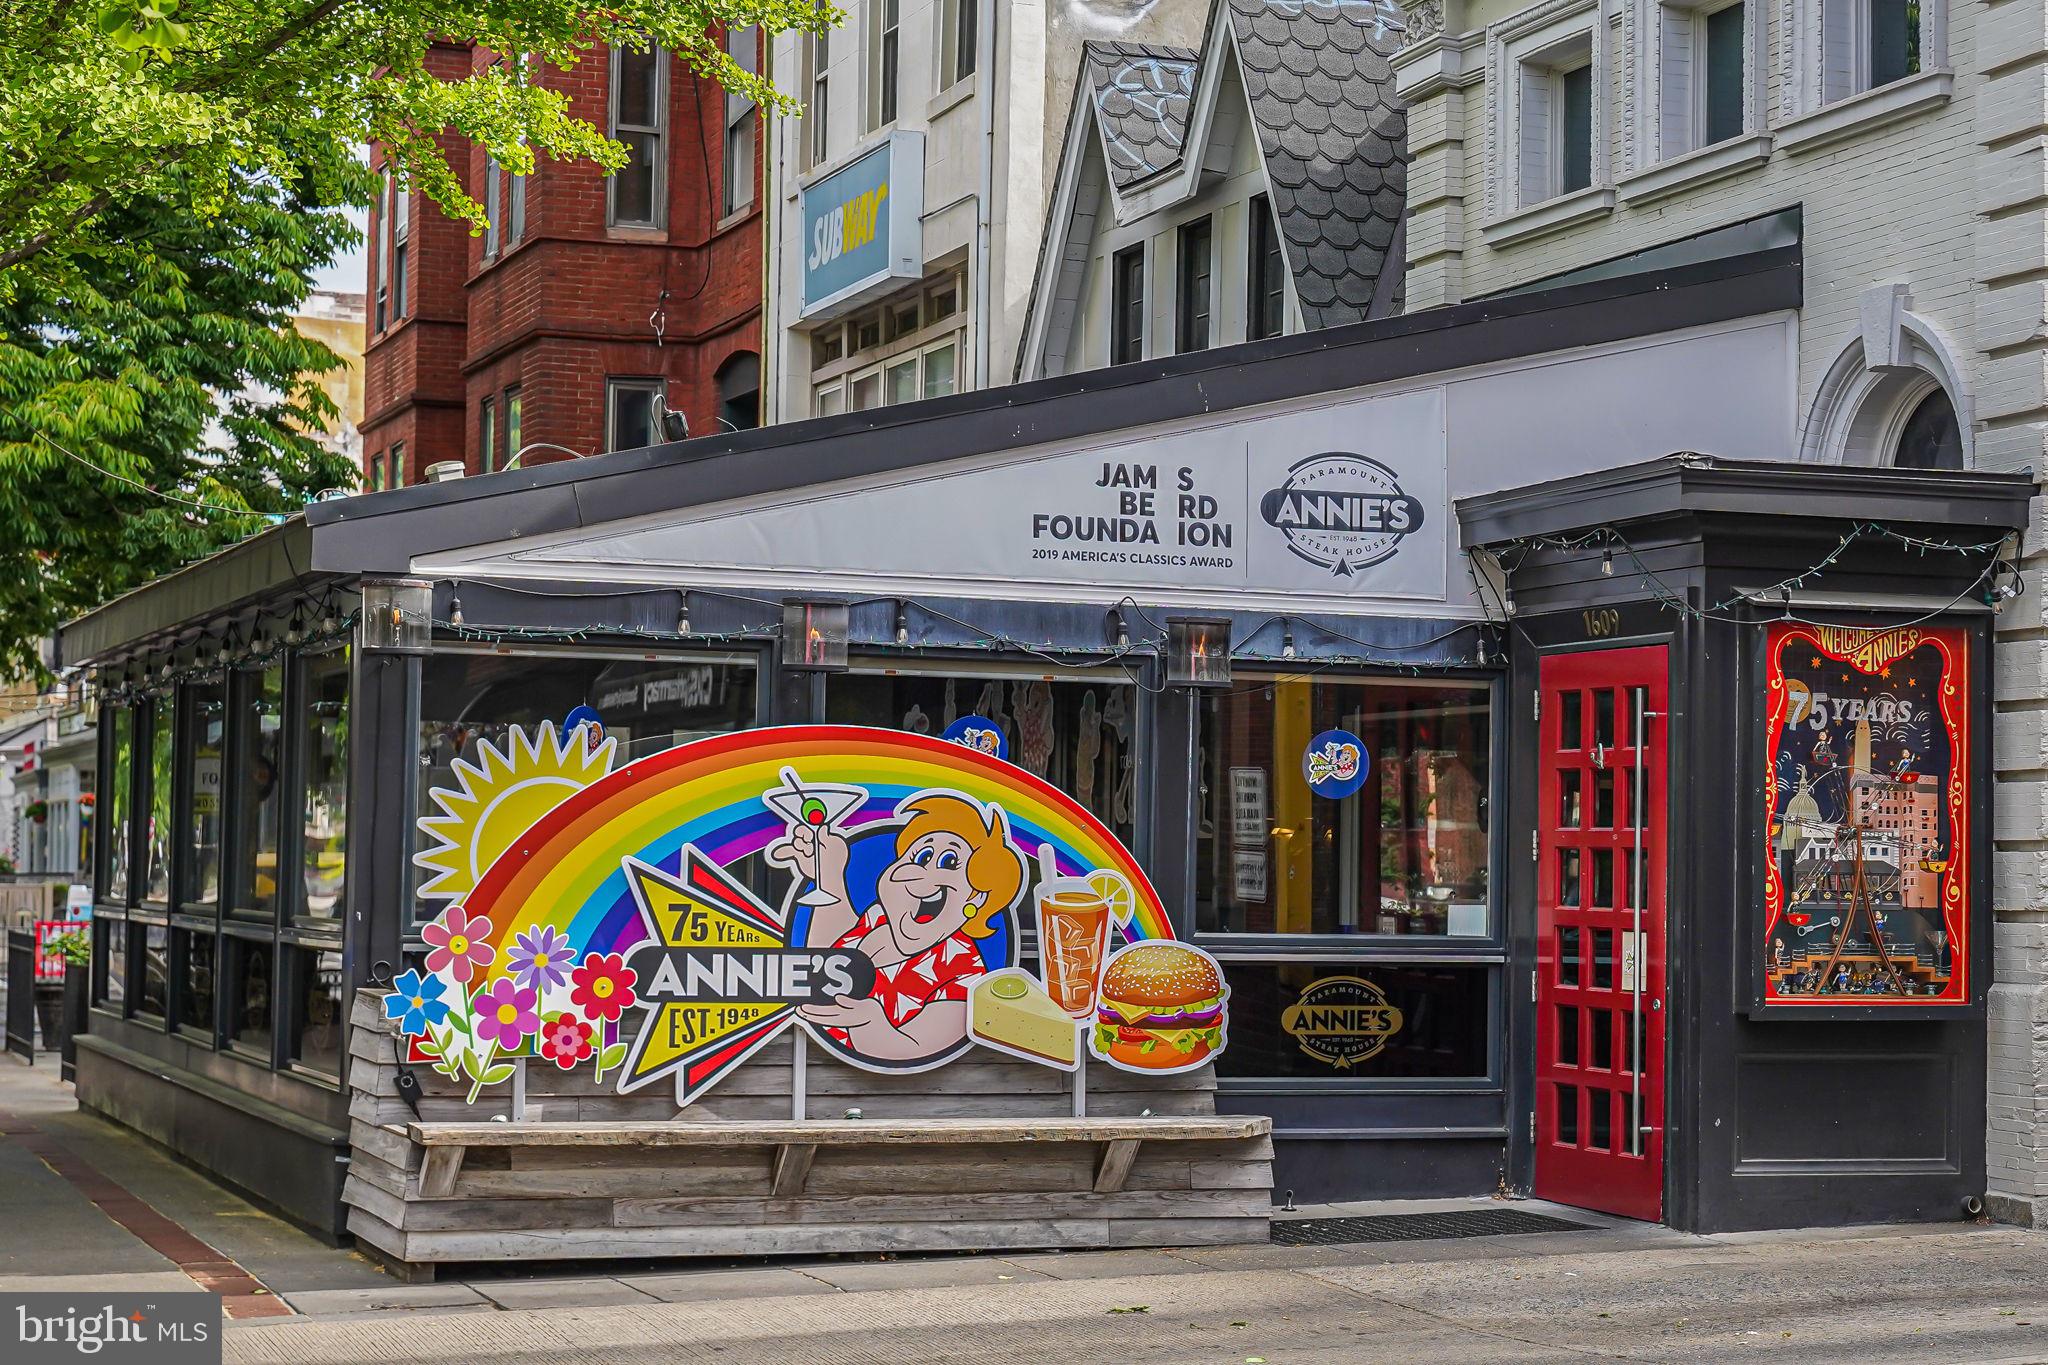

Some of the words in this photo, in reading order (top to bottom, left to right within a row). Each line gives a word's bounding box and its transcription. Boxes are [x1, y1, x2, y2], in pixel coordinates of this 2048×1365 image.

[808, 181, 889, 274] SUBWAY
[1300, 466, 1387, 489] PARAMOUNT
[1274, 493, 1410, 530] ANNIE'S
[1032, 548, 1059, 560] 2019
[1061, 551, 1127, 564] AMERICA'S
[1129, 553, 1187, 567] CLASSICS
[1189, 556, 1234, 569] AWARD
[1300, 534, 1339, 556] STEAK
[1346, 537, 1388, 557] HOUSE
[1583, 608, 1619, 637] 1609
[1815, 625, 1874, 654] WELCOME
[1789, 691, 1828, 731] 75
[1831, 698, 1913, 723] YEARS
[668, 904, 709, 942] 75
[646, 953, 853, 997] ANNIE'S
[1311, 986, 1376, 1003] PARAMOUNT
[669, 1008, 716, 1048] EST.
[717, 1008, 759, 1029] 1948
[1292, 1009, 1392, 1032] ANNIE'S
[1309, 1038, 1339, 1053] STEAK
[1344, 1038, 1375, 1053] HOUSE
